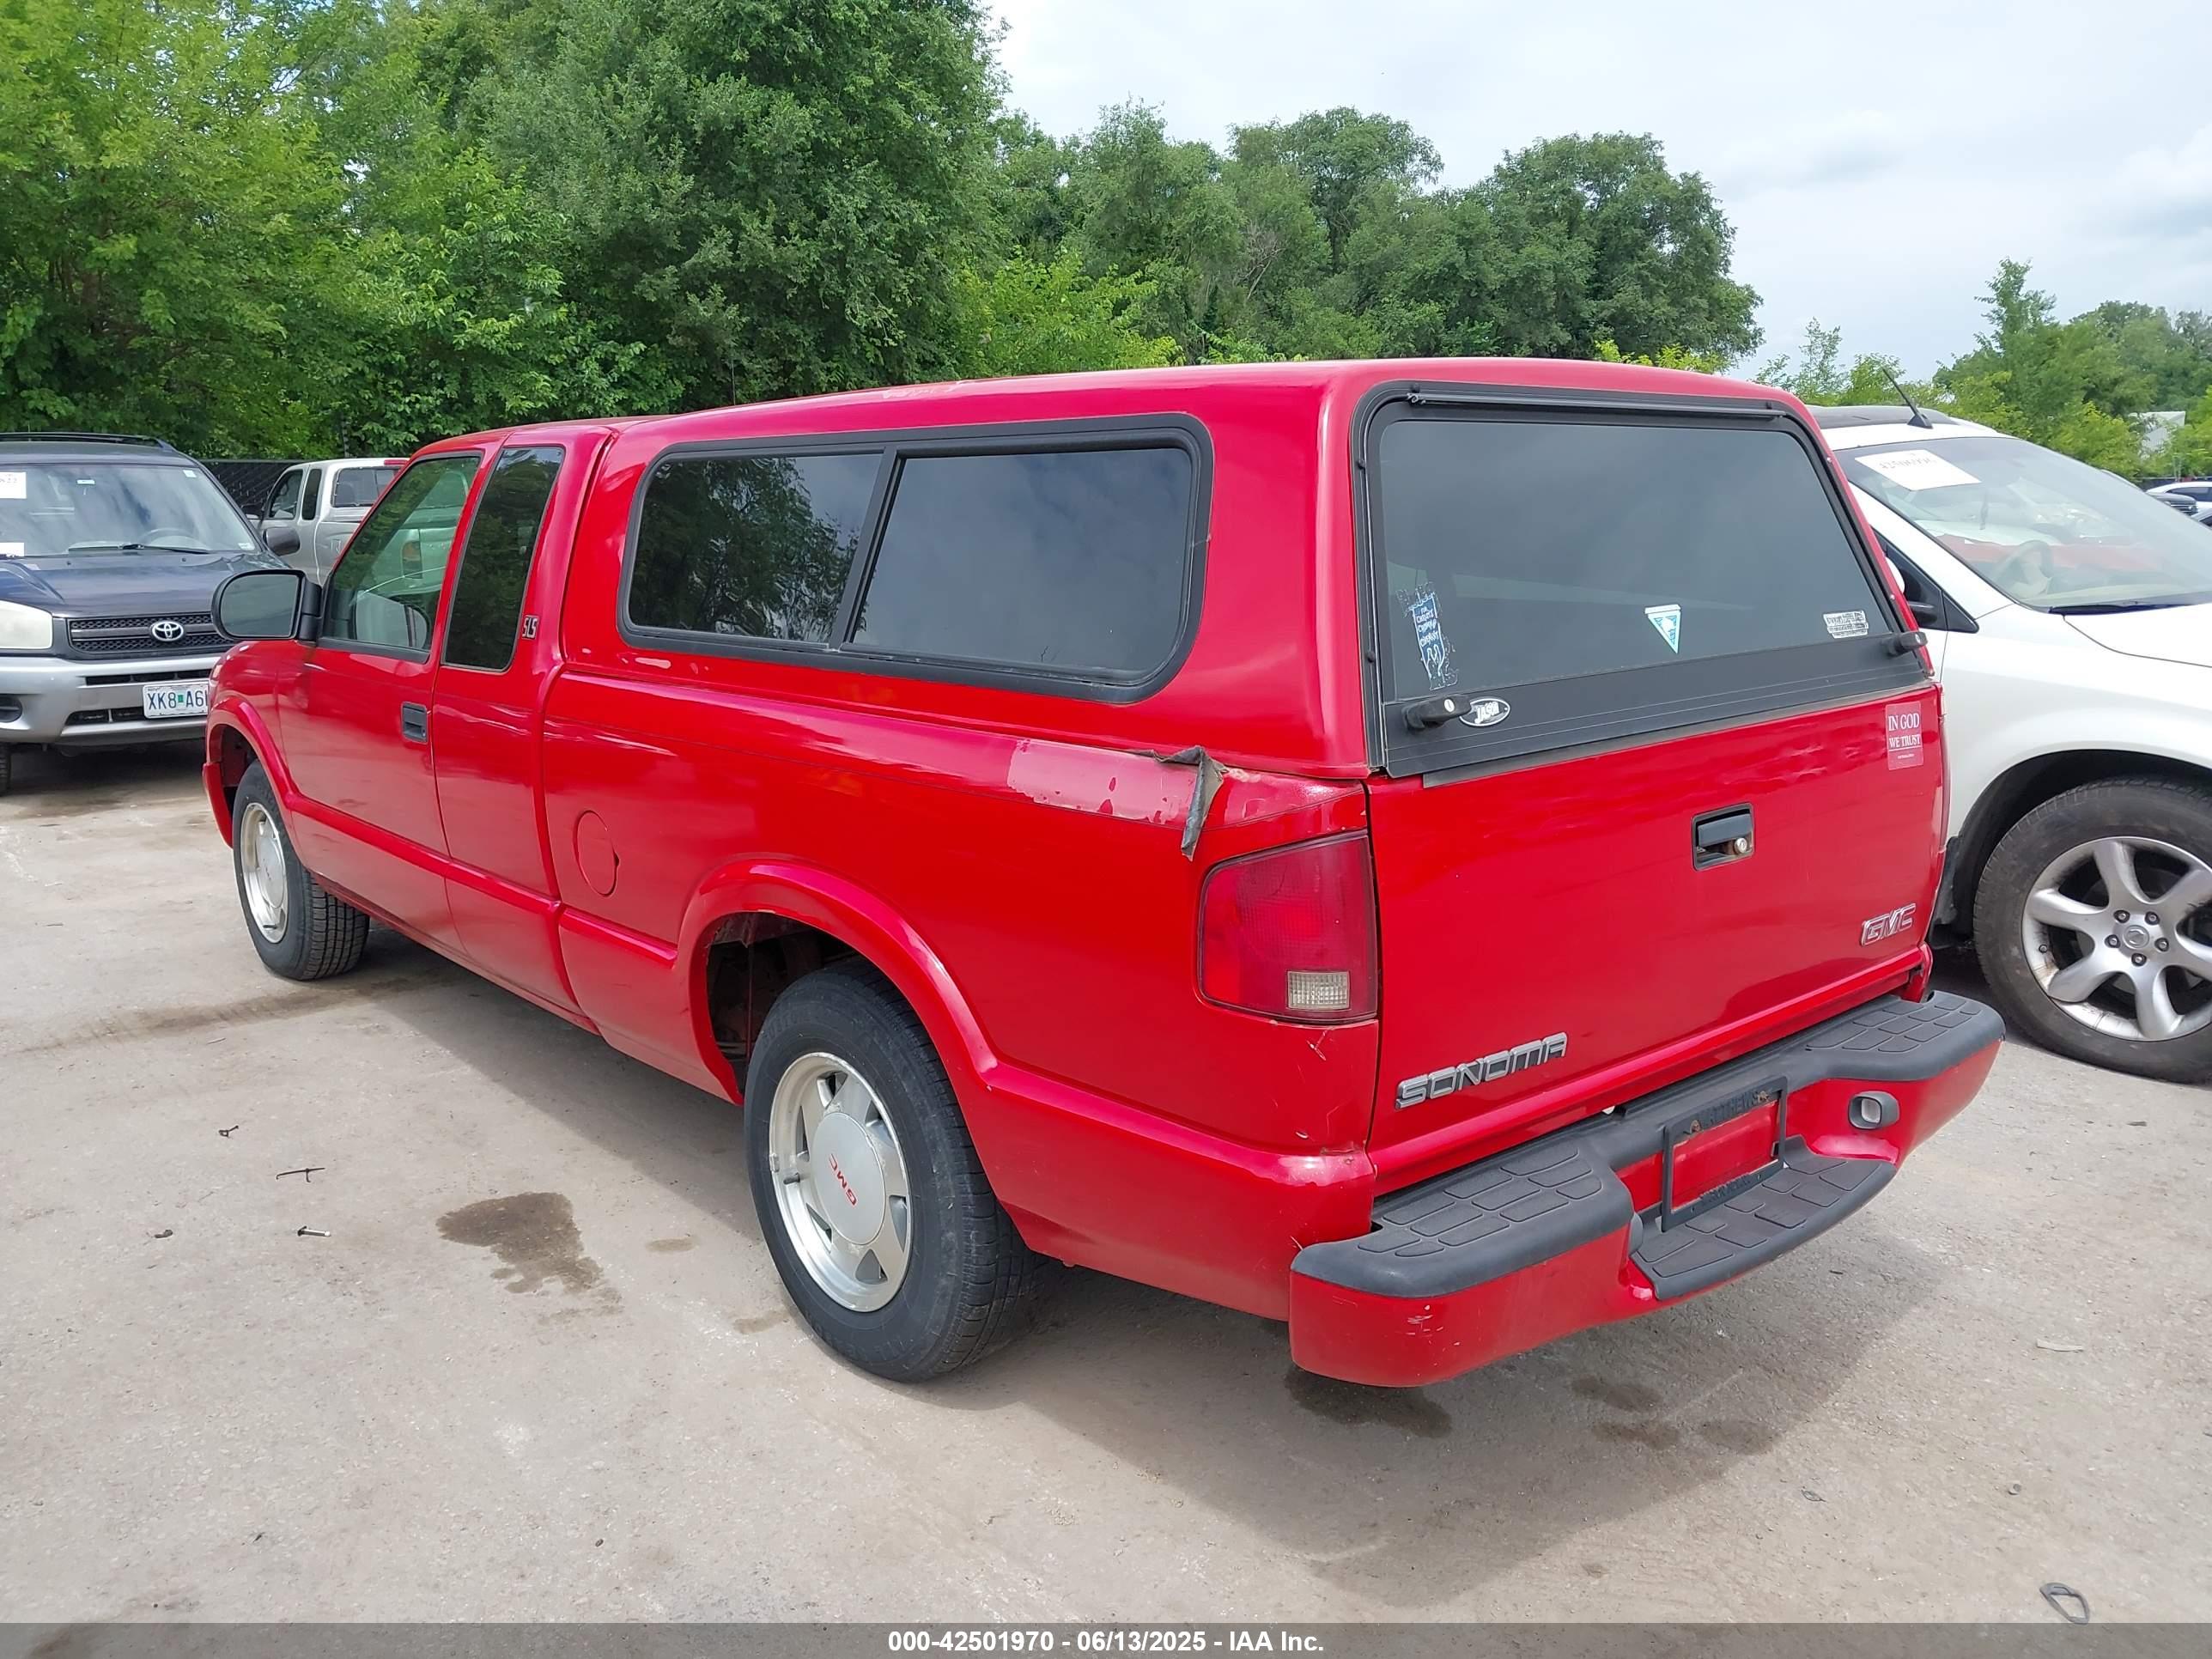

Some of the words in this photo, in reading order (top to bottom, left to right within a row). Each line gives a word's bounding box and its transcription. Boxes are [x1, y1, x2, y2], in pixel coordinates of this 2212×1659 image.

[147, 692, 177, 710] XK8
[1888, 715, 1899, 731] IN
[1899, 713, 1920, 730] GOD
[1889, 736, 1900, 748] WE
[1900, 734, 1921, 747] TRUST
[1860, 902, 1917, 946] GMC
[1395, 1031, 1568, 1109] SONOMA
[828, 1153, 857, 1206] GMC
